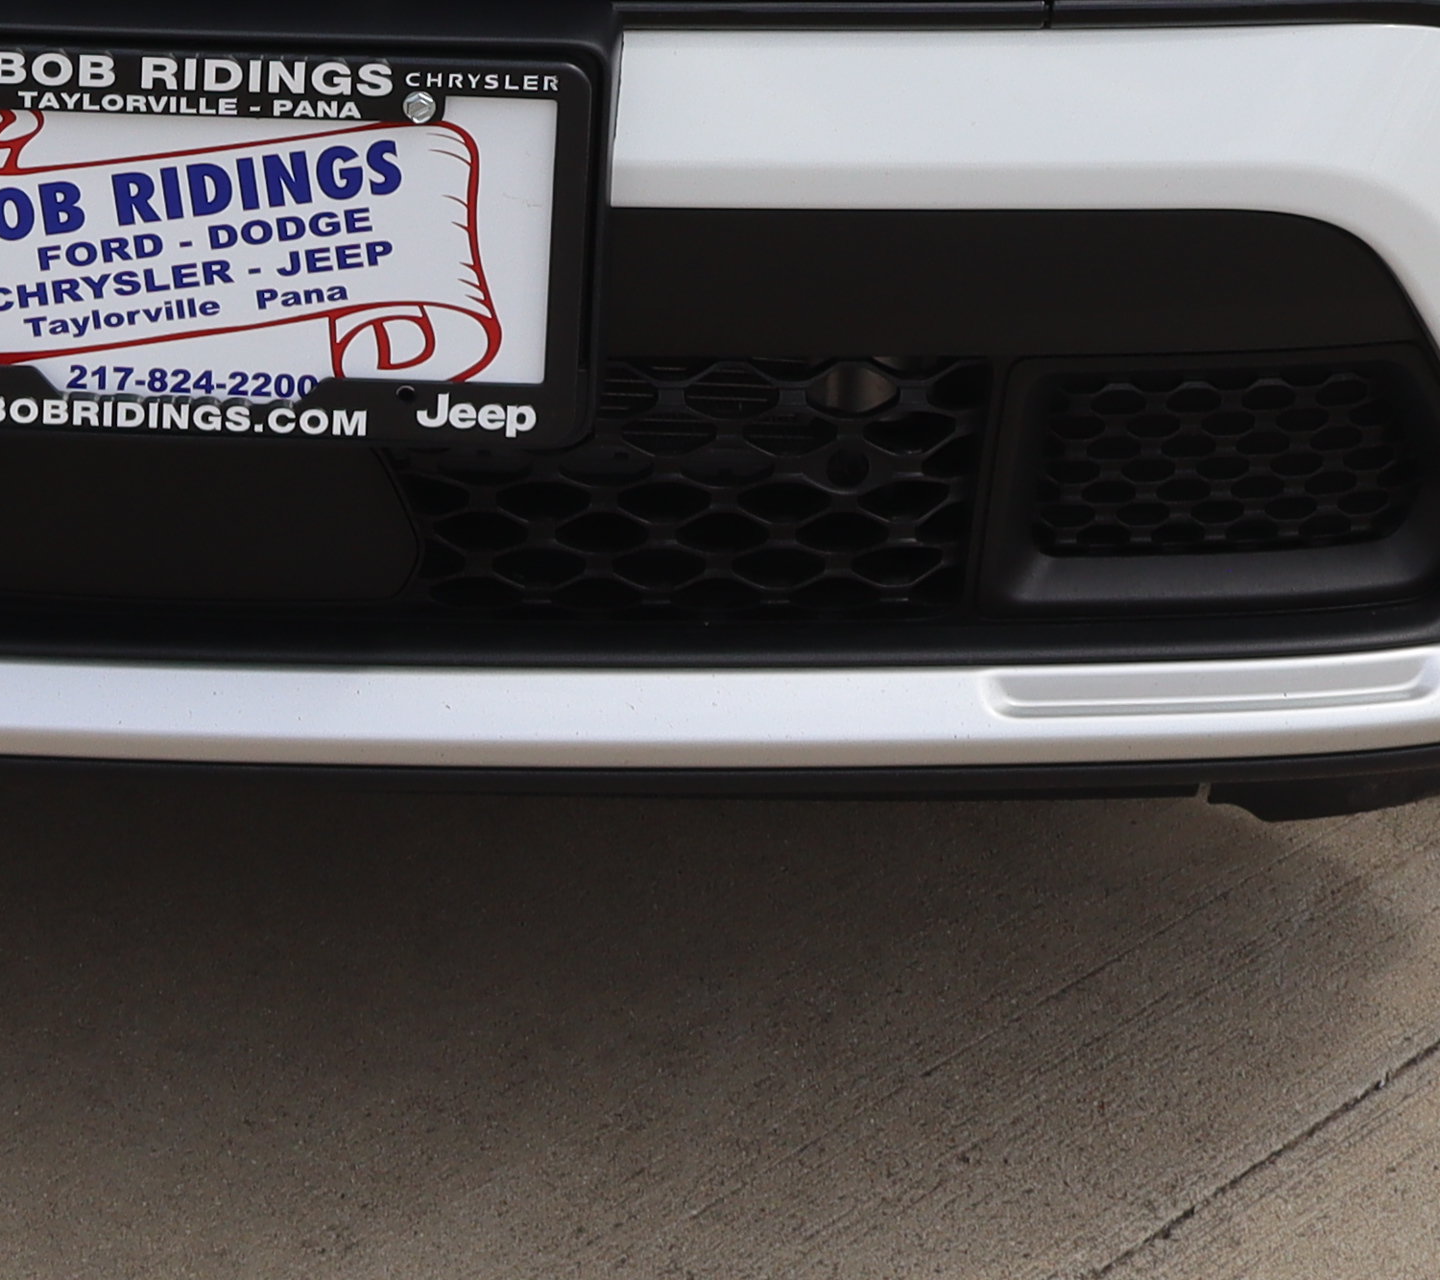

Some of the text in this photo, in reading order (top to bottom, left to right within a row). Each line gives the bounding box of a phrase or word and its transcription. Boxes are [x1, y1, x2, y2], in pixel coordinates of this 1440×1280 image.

[140, 56, 394, 97] RIDINGS
[405, 71, 559, 92] CHRYSLER
[17, 91, 238, 116] TAYLORVILLE
[272, 99, 362, 119] PANA
[111, 139, 403, 227] RIDINGS
[37, 233, 164, 272] FORD
[207, 207, 373, 250] DODGE
[276, 240, 394, 277] JEEP
[23, 285, 349, 338] Taylorville Pana
[65, 364, 320, 400] 217-824-2200
[416, 392, 537, 438] Jeep
